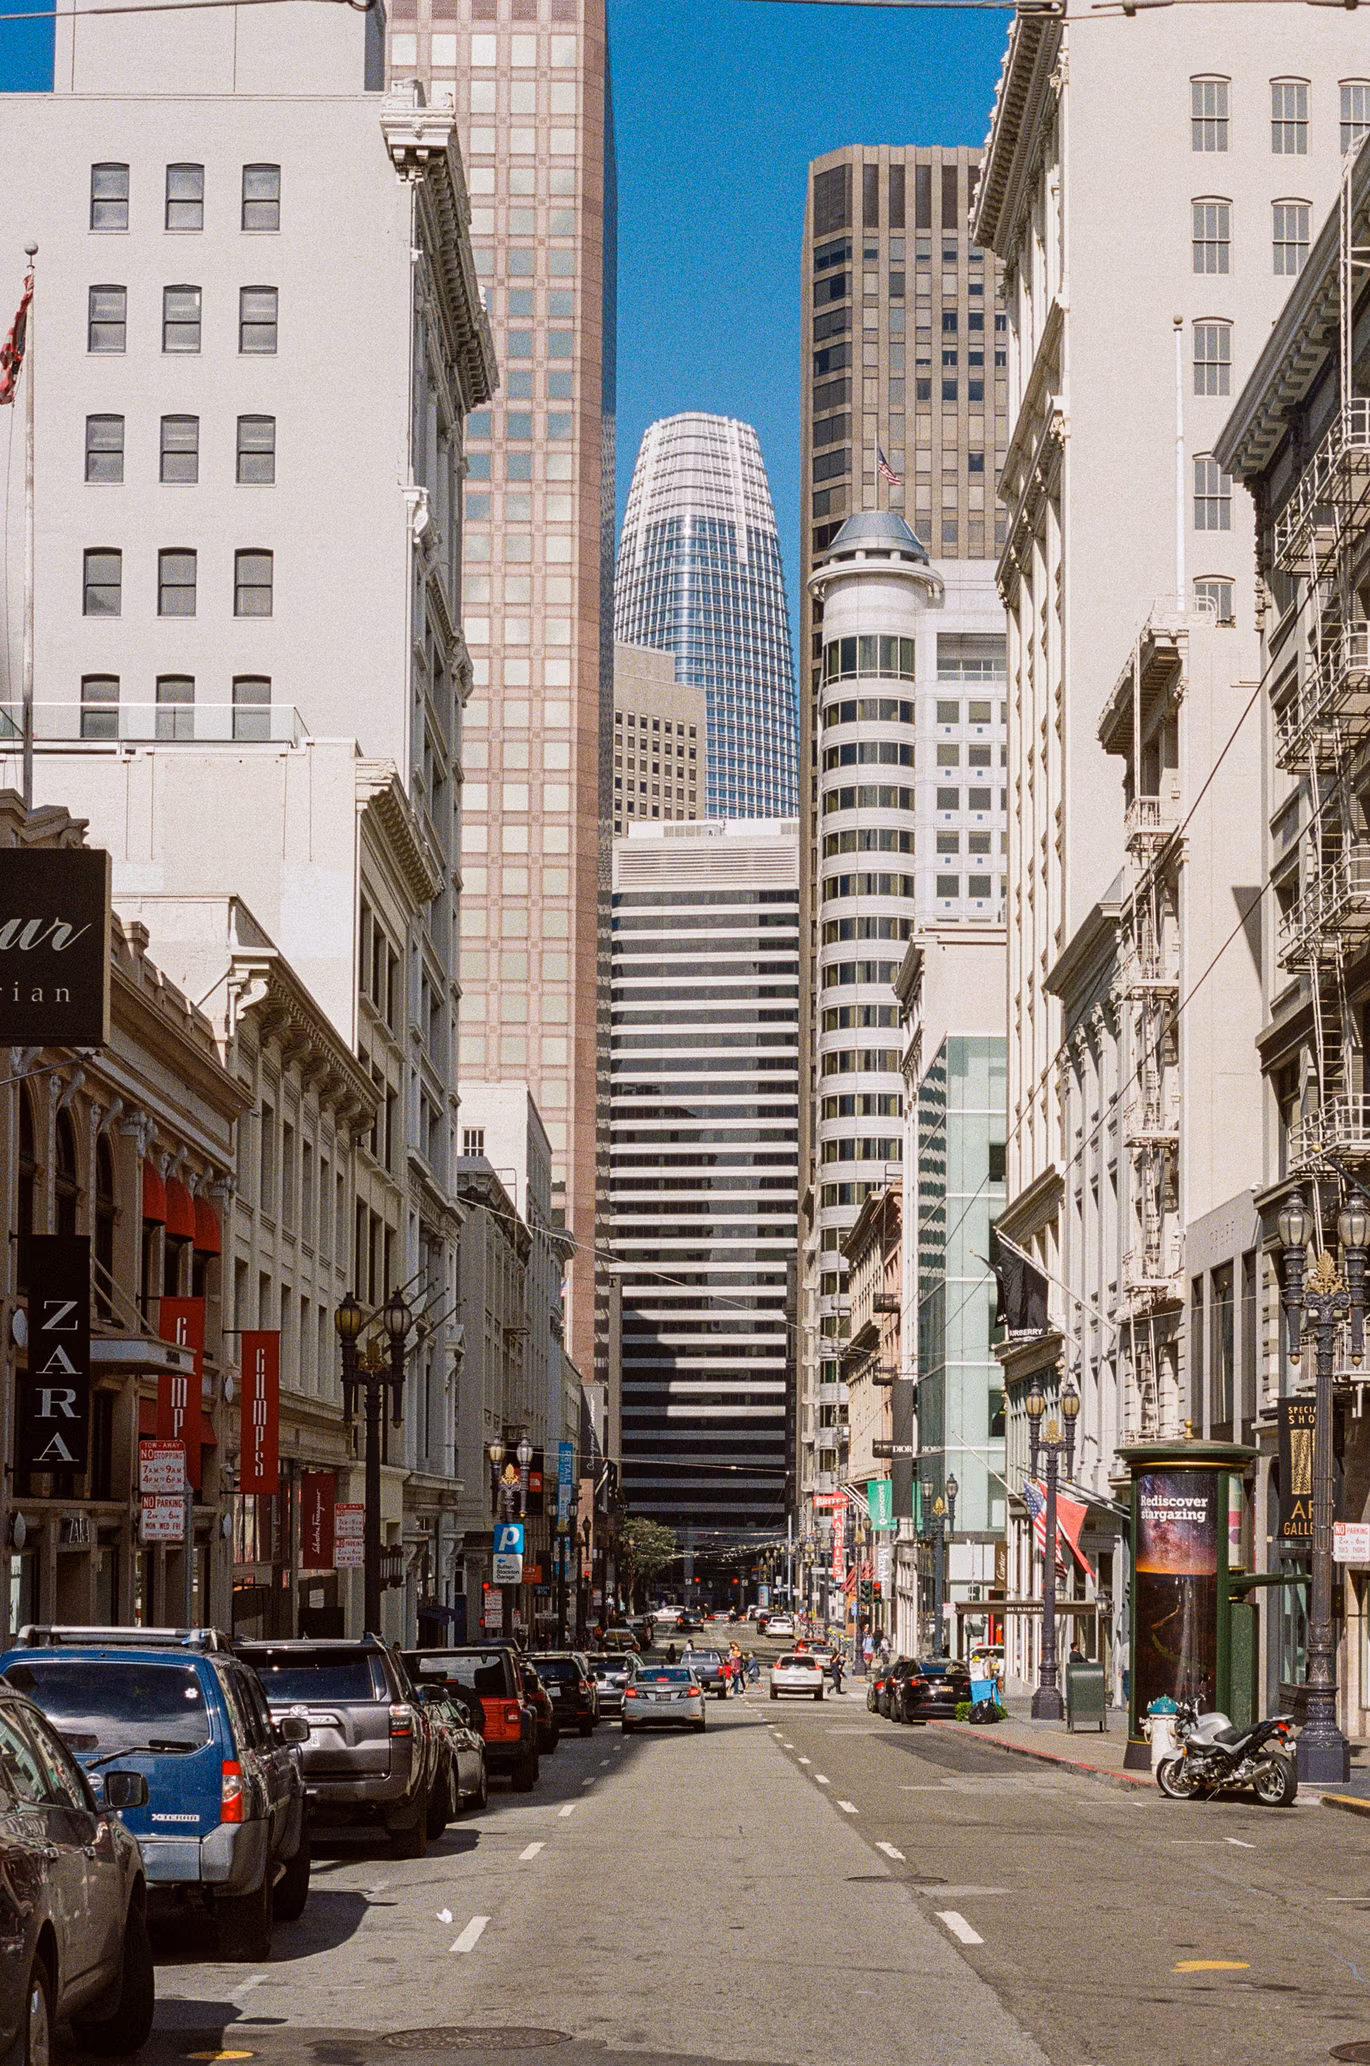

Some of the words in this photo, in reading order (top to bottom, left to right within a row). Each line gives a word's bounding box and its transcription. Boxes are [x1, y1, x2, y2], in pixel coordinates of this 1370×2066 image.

[0, 981, 71, 1003] ian
[32, 1301, 83, 1462] ZARA
[171, 1317, 187, 1442] GMP
[140, 1449, 154, 1459] NO
[892, 1445, 913, 1453] DIOR
[564, 1450, 572, 1484] RETAIL
[143, 1495, 155, 1506] NO
[156, 1499, 183, 1508] PARKING
[877, 1485, 887, 1518] concord
[1140, 1494, 1208, 1507] Rediscover
[1141, 1508, 1207, 1522] stargazing
[1335, 1525, 1346, 1535] NO
[1347, 1527, 1369, 1535] PARKING
[833, 1509, 843, 1576] FABRICS
[996, 1551, 1006, 1580] Cartier
